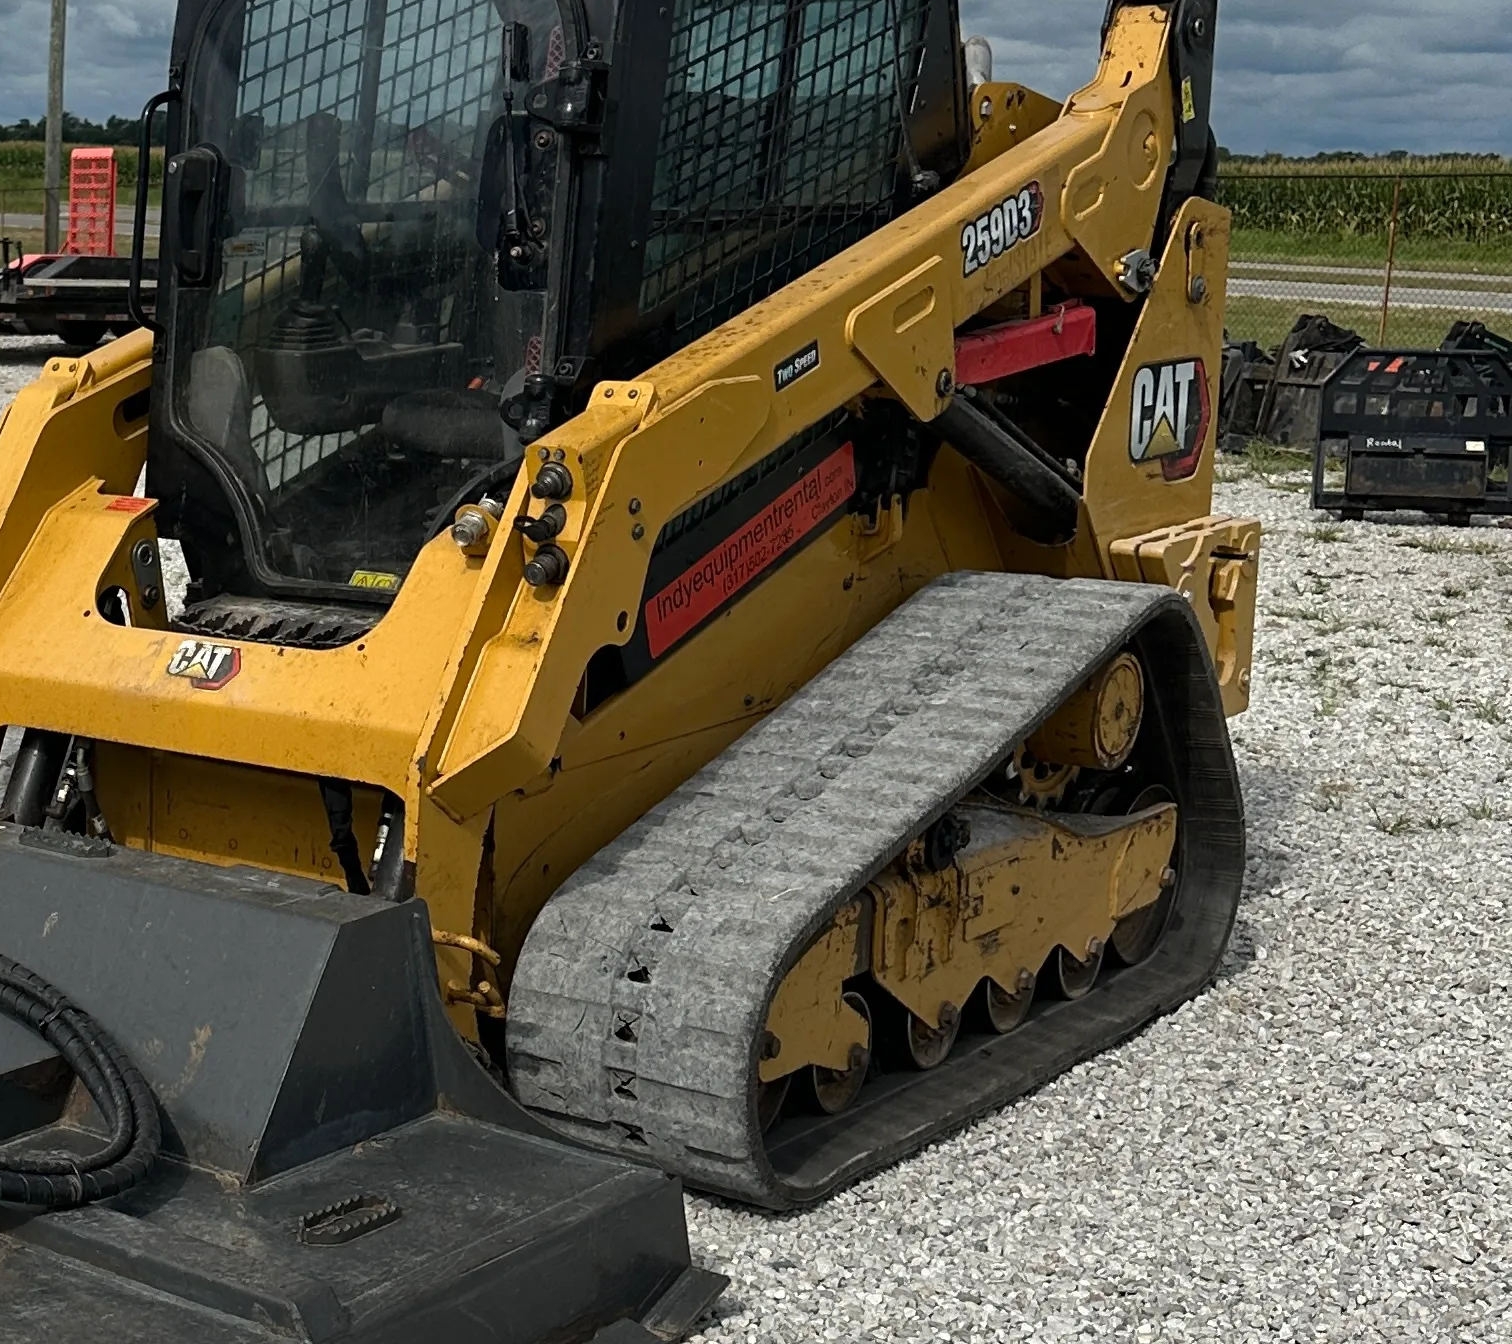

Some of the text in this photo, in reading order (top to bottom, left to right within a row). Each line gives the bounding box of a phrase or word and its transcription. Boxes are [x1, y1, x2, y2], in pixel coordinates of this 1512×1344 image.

[961, 188, 1033, 275] 259D3
[1130, 361, 1195, 460] CAT
[168, 639, 233, 680] CAT
